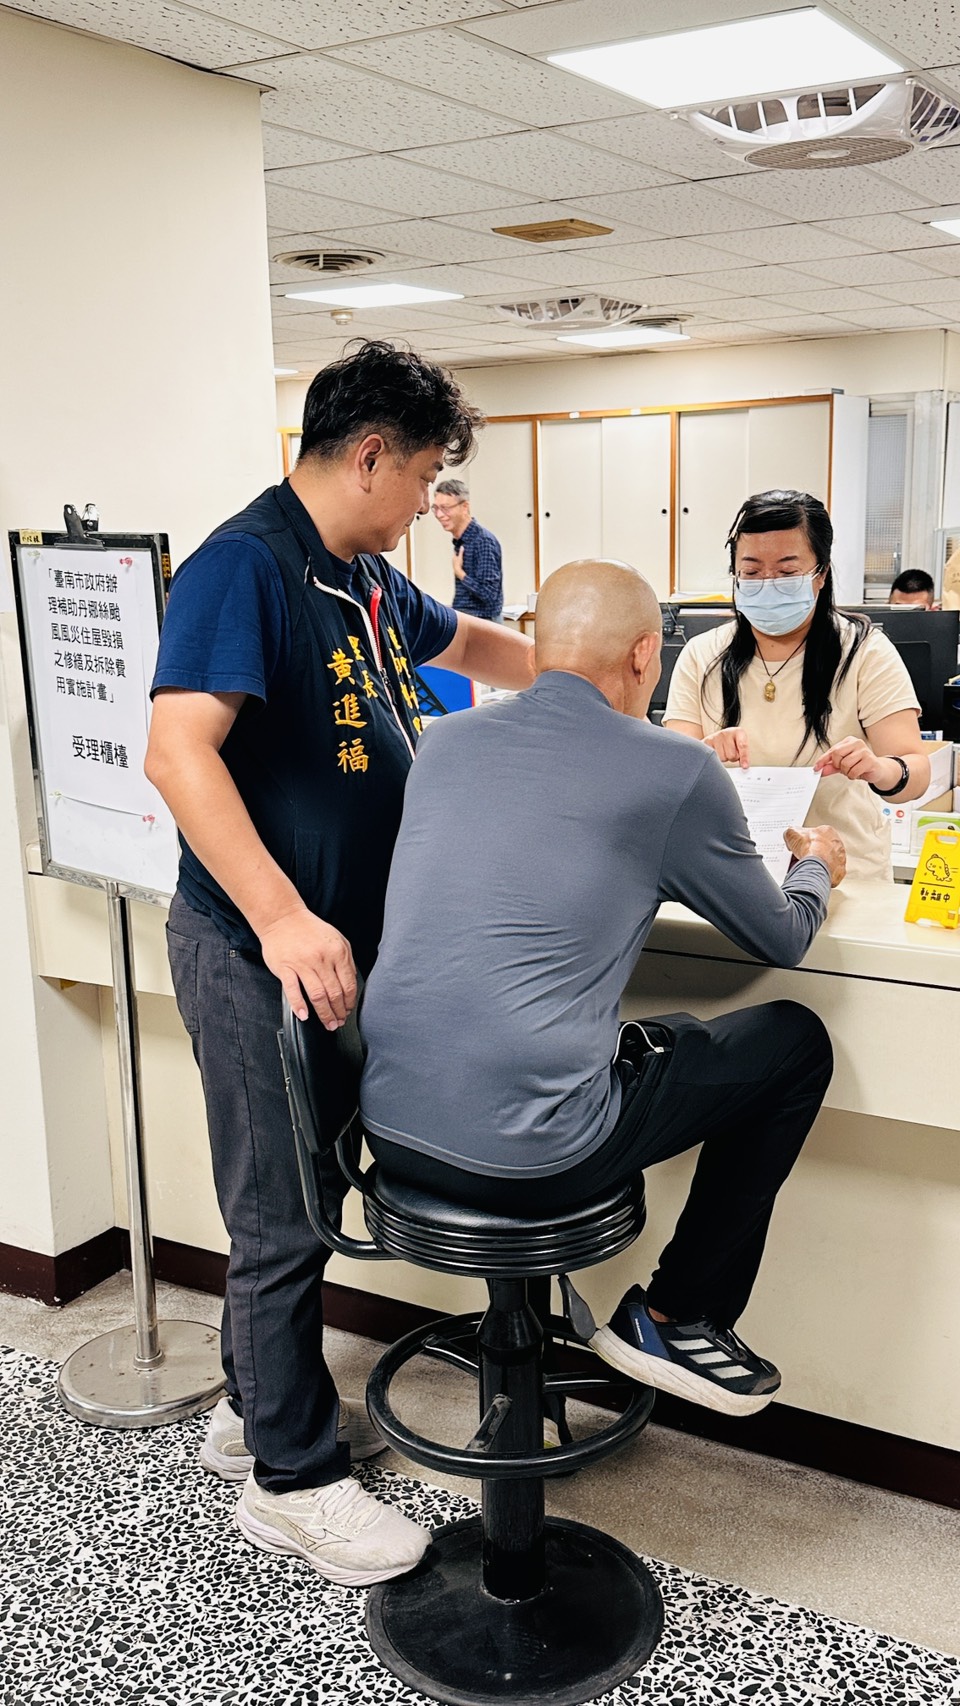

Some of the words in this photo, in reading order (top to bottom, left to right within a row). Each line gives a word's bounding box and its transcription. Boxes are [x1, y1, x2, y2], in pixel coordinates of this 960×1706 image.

[48, 567, 118, 593] 「臺南市政府辦
[51, 622, 124, 650] 風風災住屋毀損
[54, 649, 126, 678] 之修繕及拆除費
[327, 647, 369, 773] 黃進福
[72, 735, 129, 768] 受理櫃檯
